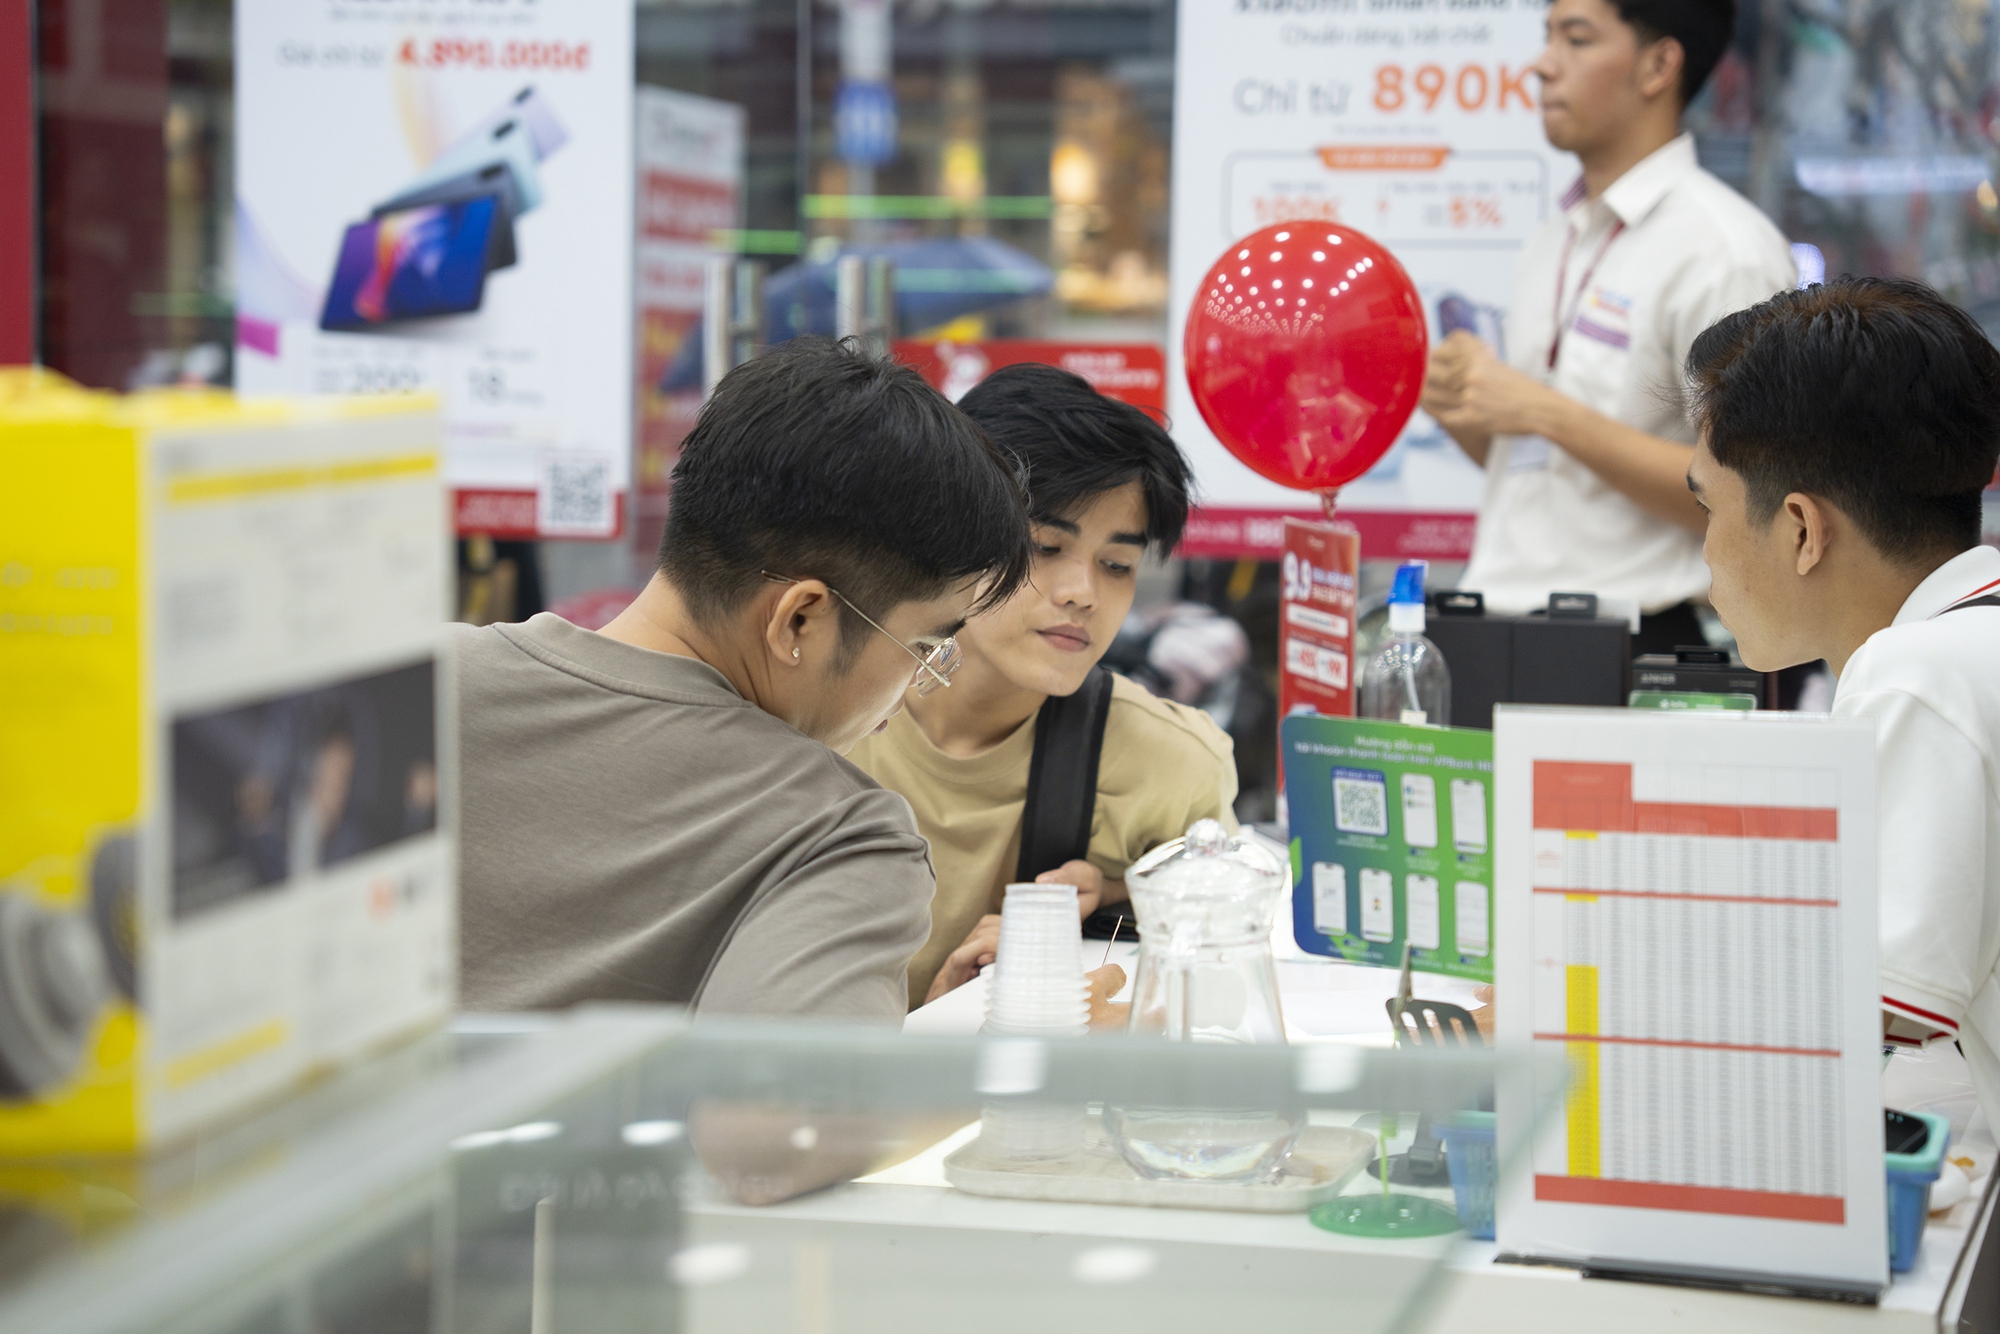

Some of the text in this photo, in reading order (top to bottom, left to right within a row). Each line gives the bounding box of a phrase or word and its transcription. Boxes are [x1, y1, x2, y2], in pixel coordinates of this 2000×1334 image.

[1233, 63, 1537, 116] Chỉ từ 890K
